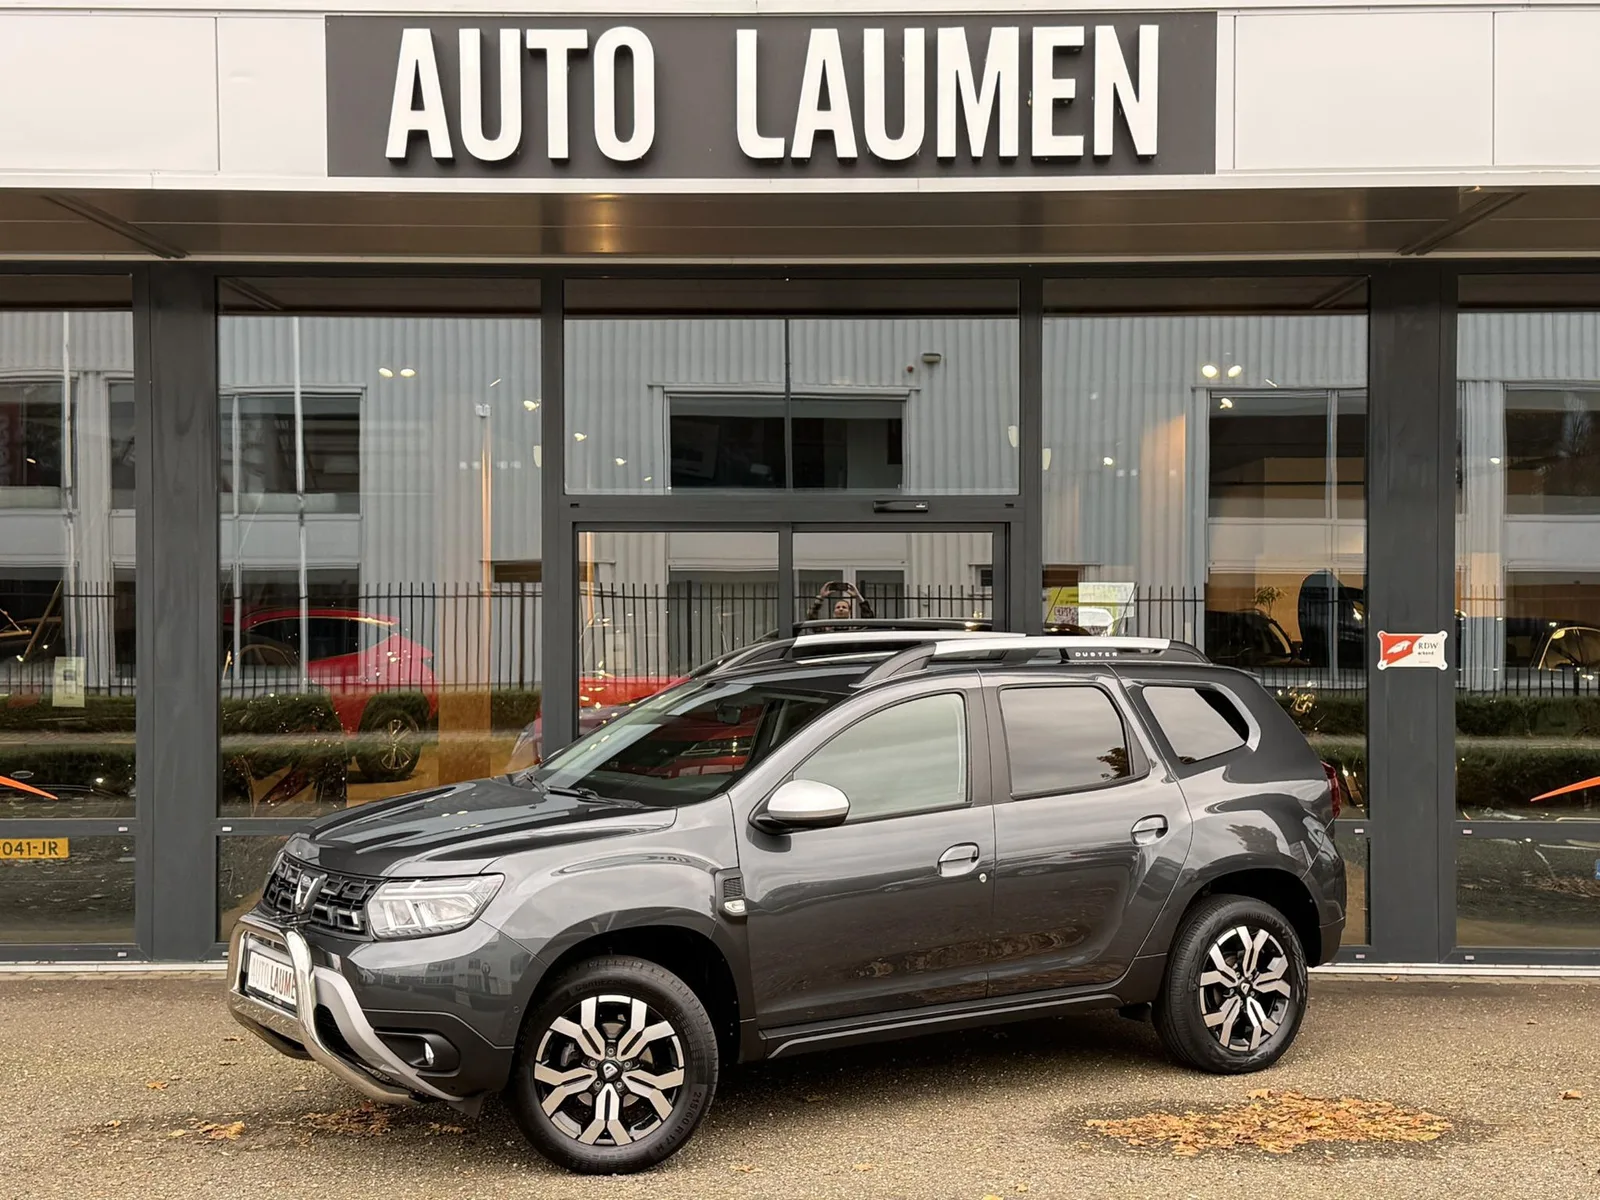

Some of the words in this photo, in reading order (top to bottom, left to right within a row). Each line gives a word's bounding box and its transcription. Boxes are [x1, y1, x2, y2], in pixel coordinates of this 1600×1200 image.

[385, 26, 655, 162] AUTO
[736, 24, 1160, 161] LAUMEN
[270, 965, 297, 999] LAUME
